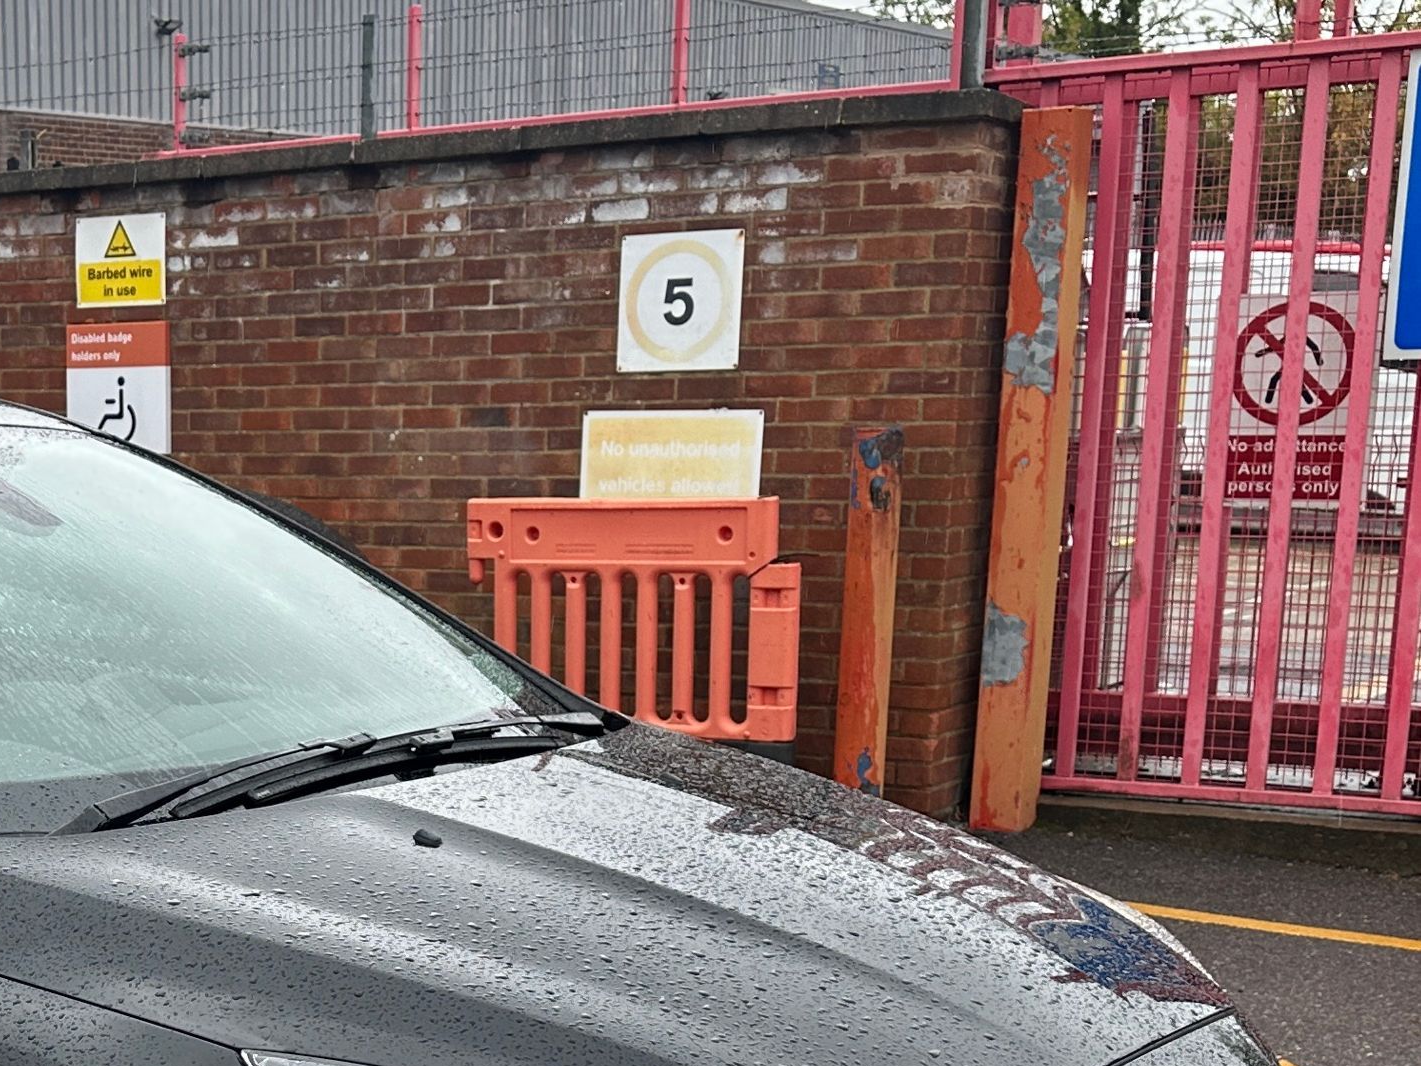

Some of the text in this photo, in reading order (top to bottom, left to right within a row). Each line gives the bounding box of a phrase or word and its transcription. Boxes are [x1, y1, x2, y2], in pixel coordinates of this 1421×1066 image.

[88, 265, 153, 281] Barbed wire
[103, 285, 136, 297] in use
[663, 277, 695, 326] 5
[71, 331, 133, 345] Disabled badge
[71, 349, 121, 363] holders only
[601, 438, 741, 459] No unauthorised
[1228, 438, 1248, 452] No
[1238, 461, 1331, 475] Autised
[598, 474, 740, 494] vehicles allowed
[1302, 480, 1339, 497] only
